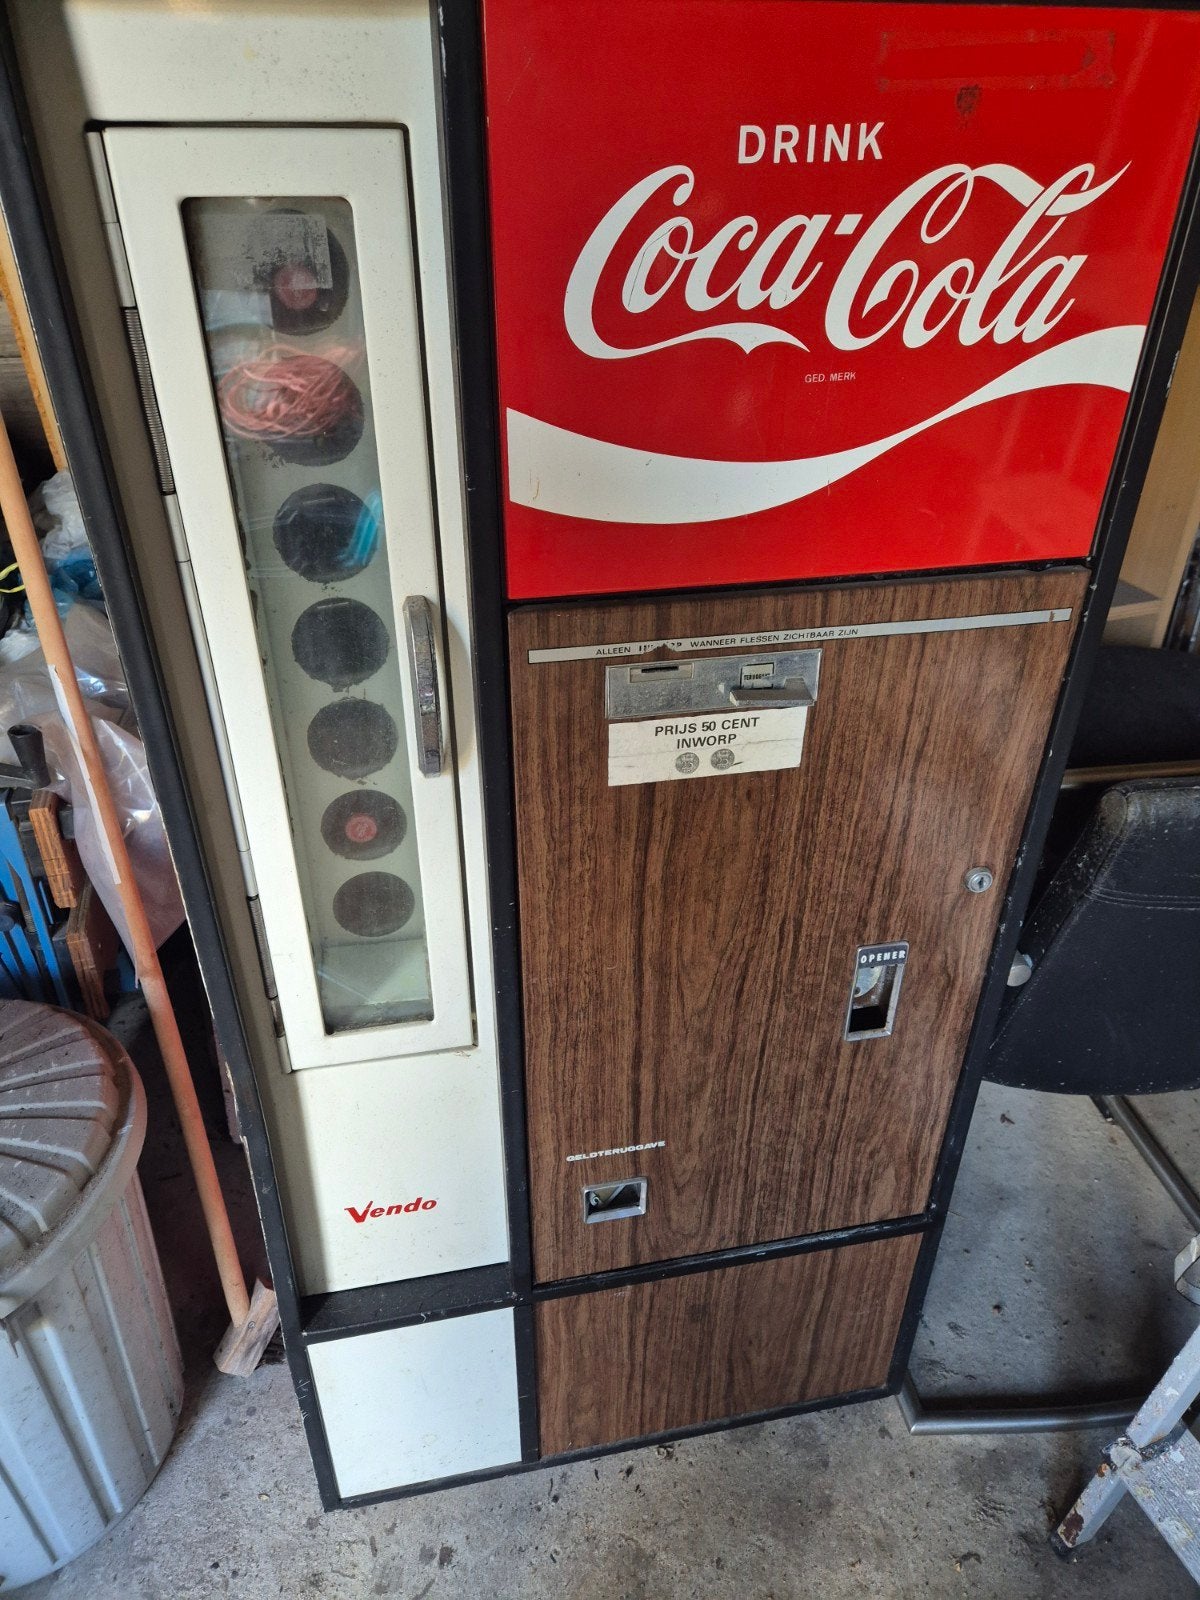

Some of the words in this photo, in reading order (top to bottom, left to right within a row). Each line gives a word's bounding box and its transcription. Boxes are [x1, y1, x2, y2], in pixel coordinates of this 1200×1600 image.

[737, 121, 885, 165] DRINK
[563, 160, 1132, 361] Coca-Cola
[829, 371, 857, 382] MERK
[595, 646, 631, 656] ALLEEN
[690, 638, 736, 648] WANNEER
[740, 635, 780, 644] FLESSEN
[783, 630, 835, 641] ZICHTBAAR
[838, 628, 859, 638] ZIJN
[654, 722, 698, 737] PRIJS
[701, 721, 717, 732] 50
[721, 717, 761, 730] CENT
[676, 733, 738, 750] INWORP
[860, 949, 906, 964] OPENER
[565, 1141, 666, 1162] GELDTERUGGAVE
[343, 1196, 438, 1224] Vendo
